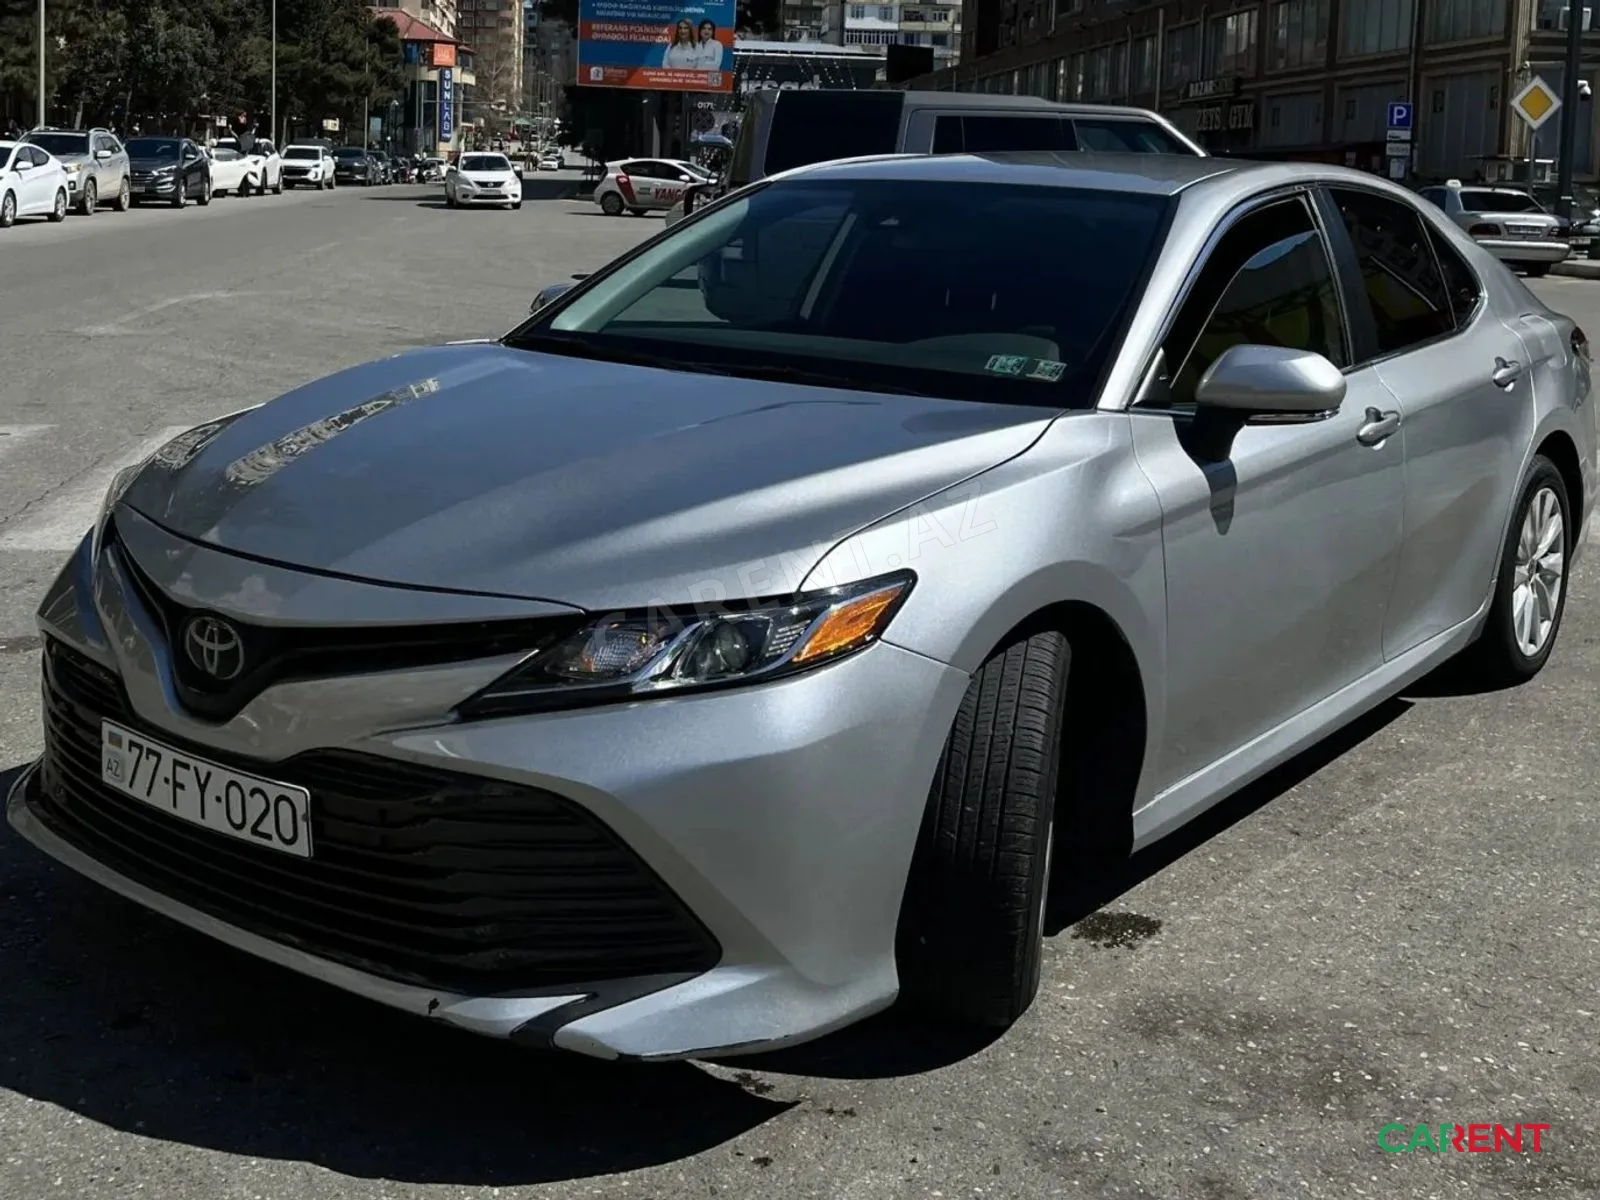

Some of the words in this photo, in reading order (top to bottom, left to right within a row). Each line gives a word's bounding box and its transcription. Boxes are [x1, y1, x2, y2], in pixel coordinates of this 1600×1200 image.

[1393, 106, 1407, 125] P
[655, 188, 687, 200] YANG
[106, 761, 120, 778] AZ
